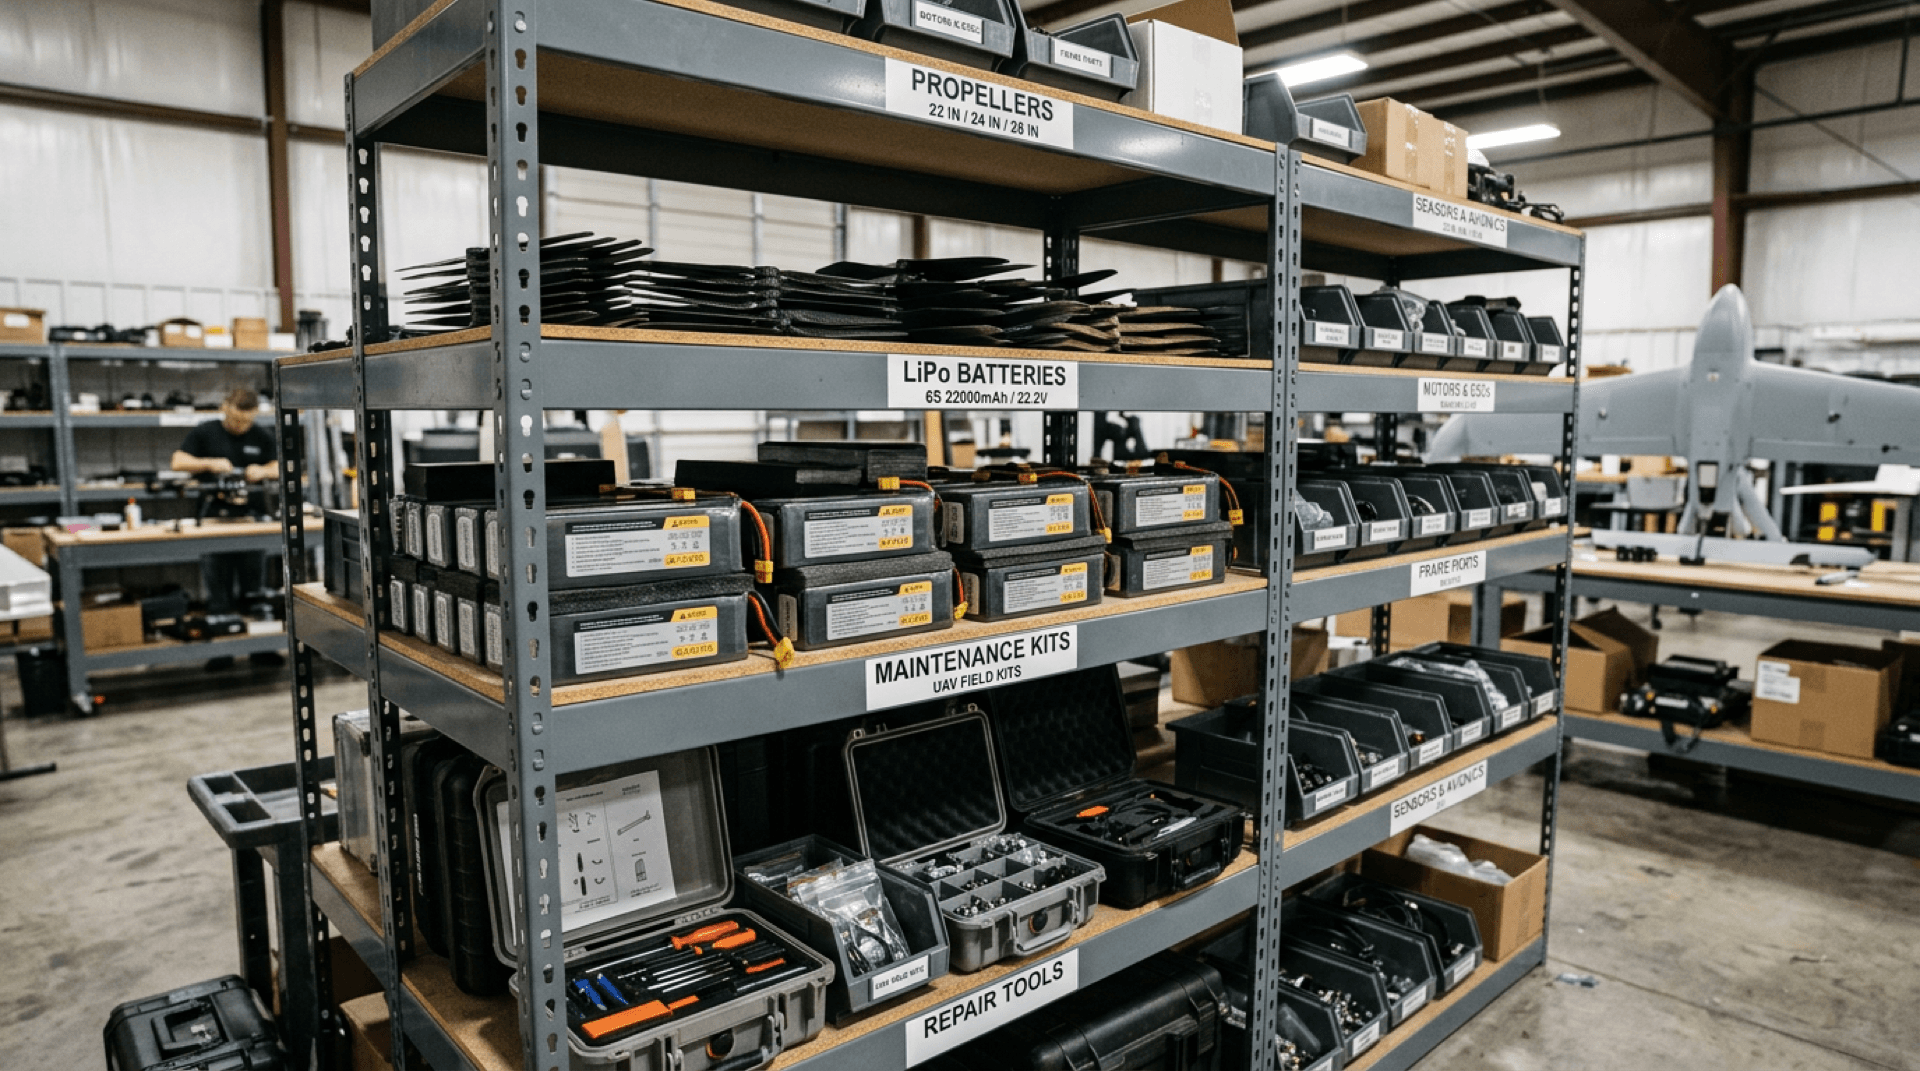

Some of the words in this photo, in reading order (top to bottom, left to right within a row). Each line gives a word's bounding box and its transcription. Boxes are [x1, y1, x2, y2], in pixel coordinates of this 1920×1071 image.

[912, 67, 1053, 121] PROPELLERS
[929, 103, 944, 118] 22
[948, 106, 960, 122] IN
[971, 112, 985, 126] 24
[989, 115, 1000, 130] IN
[1027, 123, 1038, 138] IN
[903, 360, 950, 383] LiPo
[957, 362, 1066, 386] BATTERIES
[925, 390, 941, 404] 6S
[945, 390, 1008, 404] 22000mAh
[1010, 391, 1015, 404] /
[1016, 391, 1048, 404] 22.2V
[875, 638, 1025, 685] MAINTENANCE
[1030, 631, 1071, 657] KITS
[933, 677, 957, 693] UAV
[960, 670, 993, 689] FIELD
[996, 664, 1022, 682] KITS
[924, 990, 997, 1039] REPAIR
[1002, 960, 1064, 1002] TOOLS
